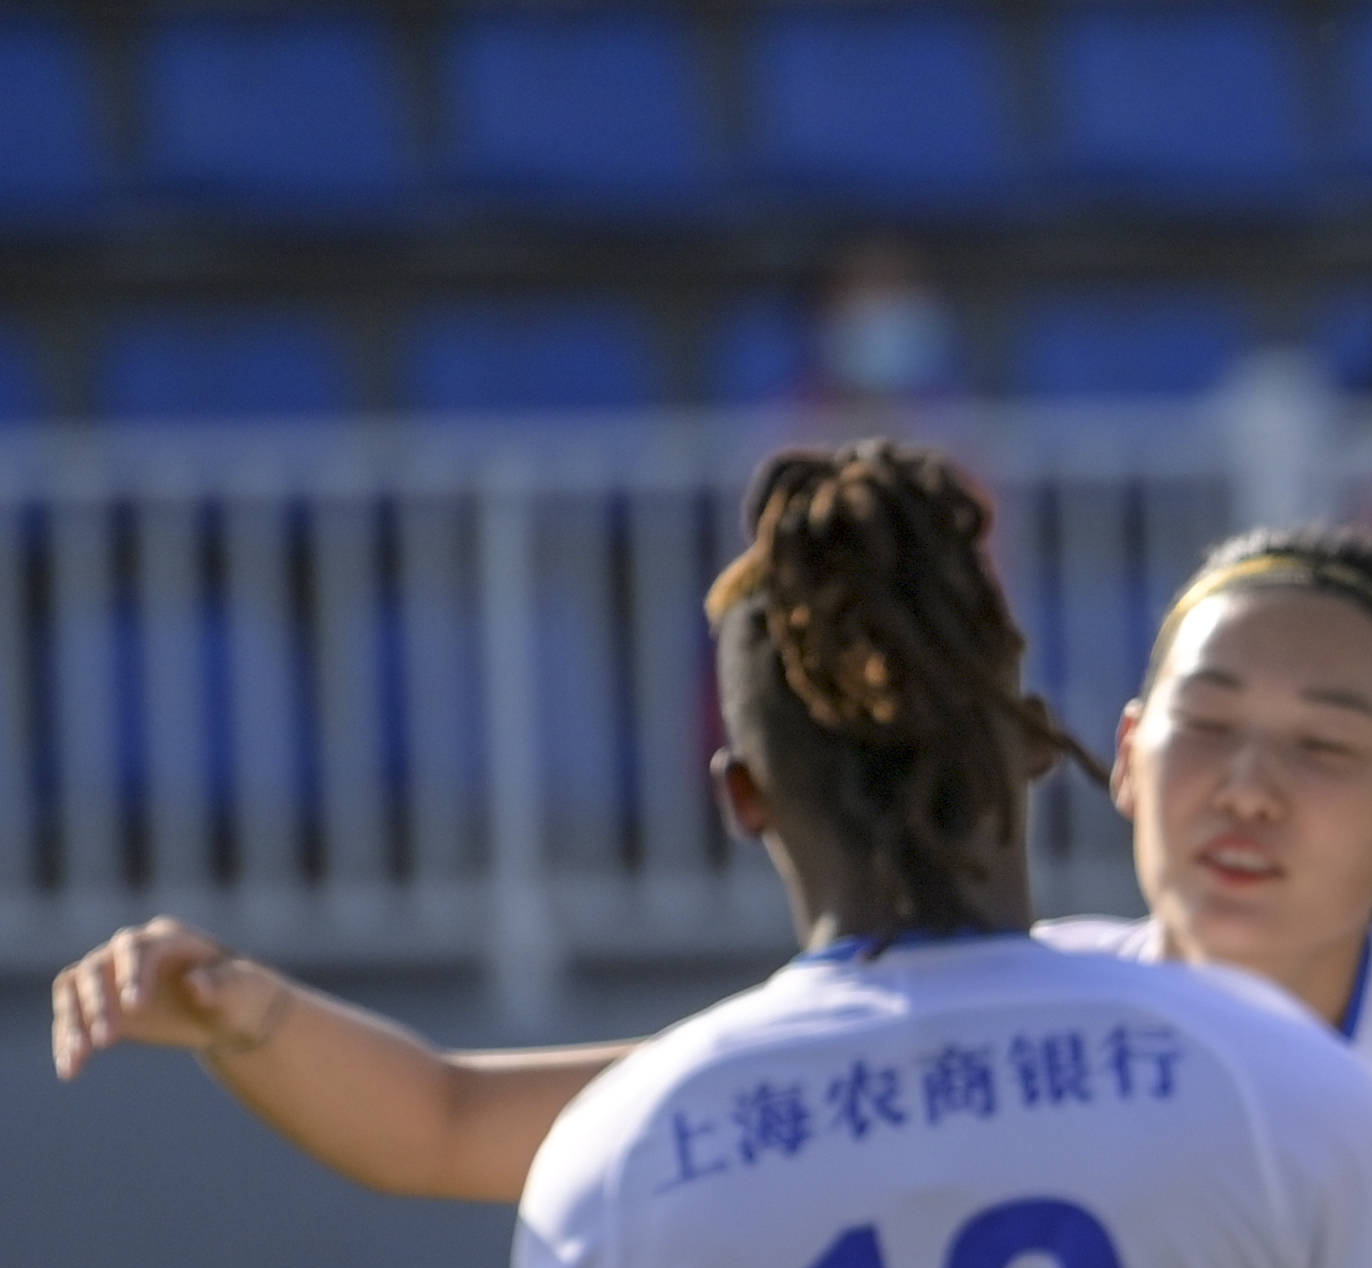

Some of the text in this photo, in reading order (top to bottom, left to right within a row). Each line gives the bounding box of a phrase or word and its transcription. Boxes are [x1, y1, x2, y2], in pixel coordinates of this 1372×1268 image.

[653, 1024, 1184, 1195] 上海农商银行
